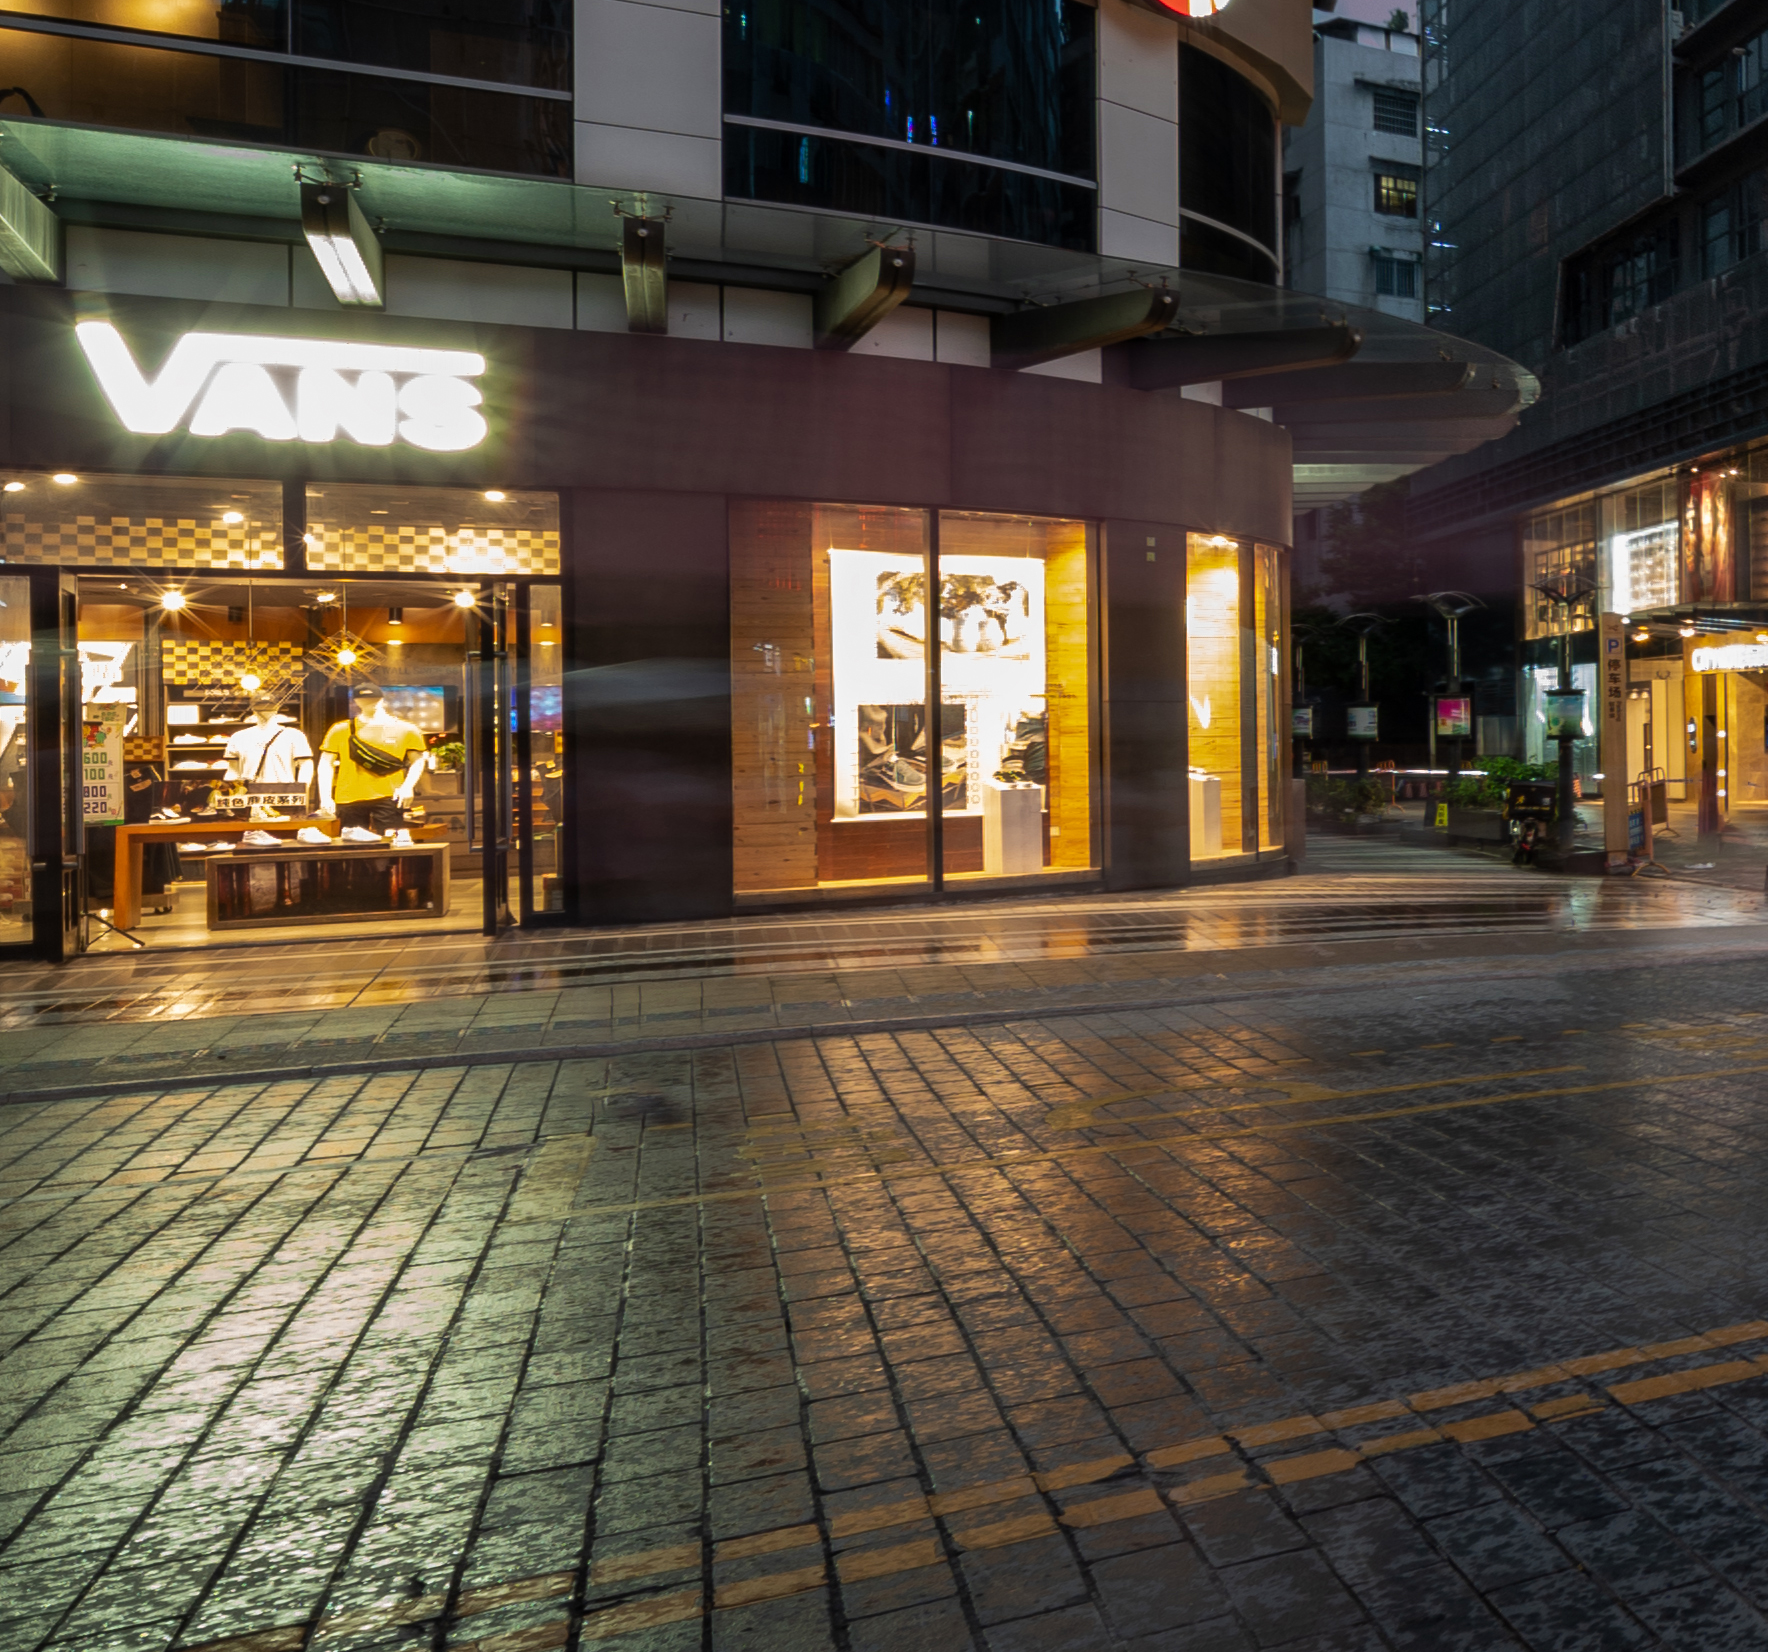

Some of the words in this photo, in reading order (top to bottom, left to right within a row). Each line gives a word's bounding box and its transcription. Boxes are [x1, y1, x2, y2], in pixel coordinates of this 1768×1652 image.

[76, 322, 486, 451] VANS
[1608, 639, 1619, 653] P
[1607, 659, 1621, 698] 停车场
